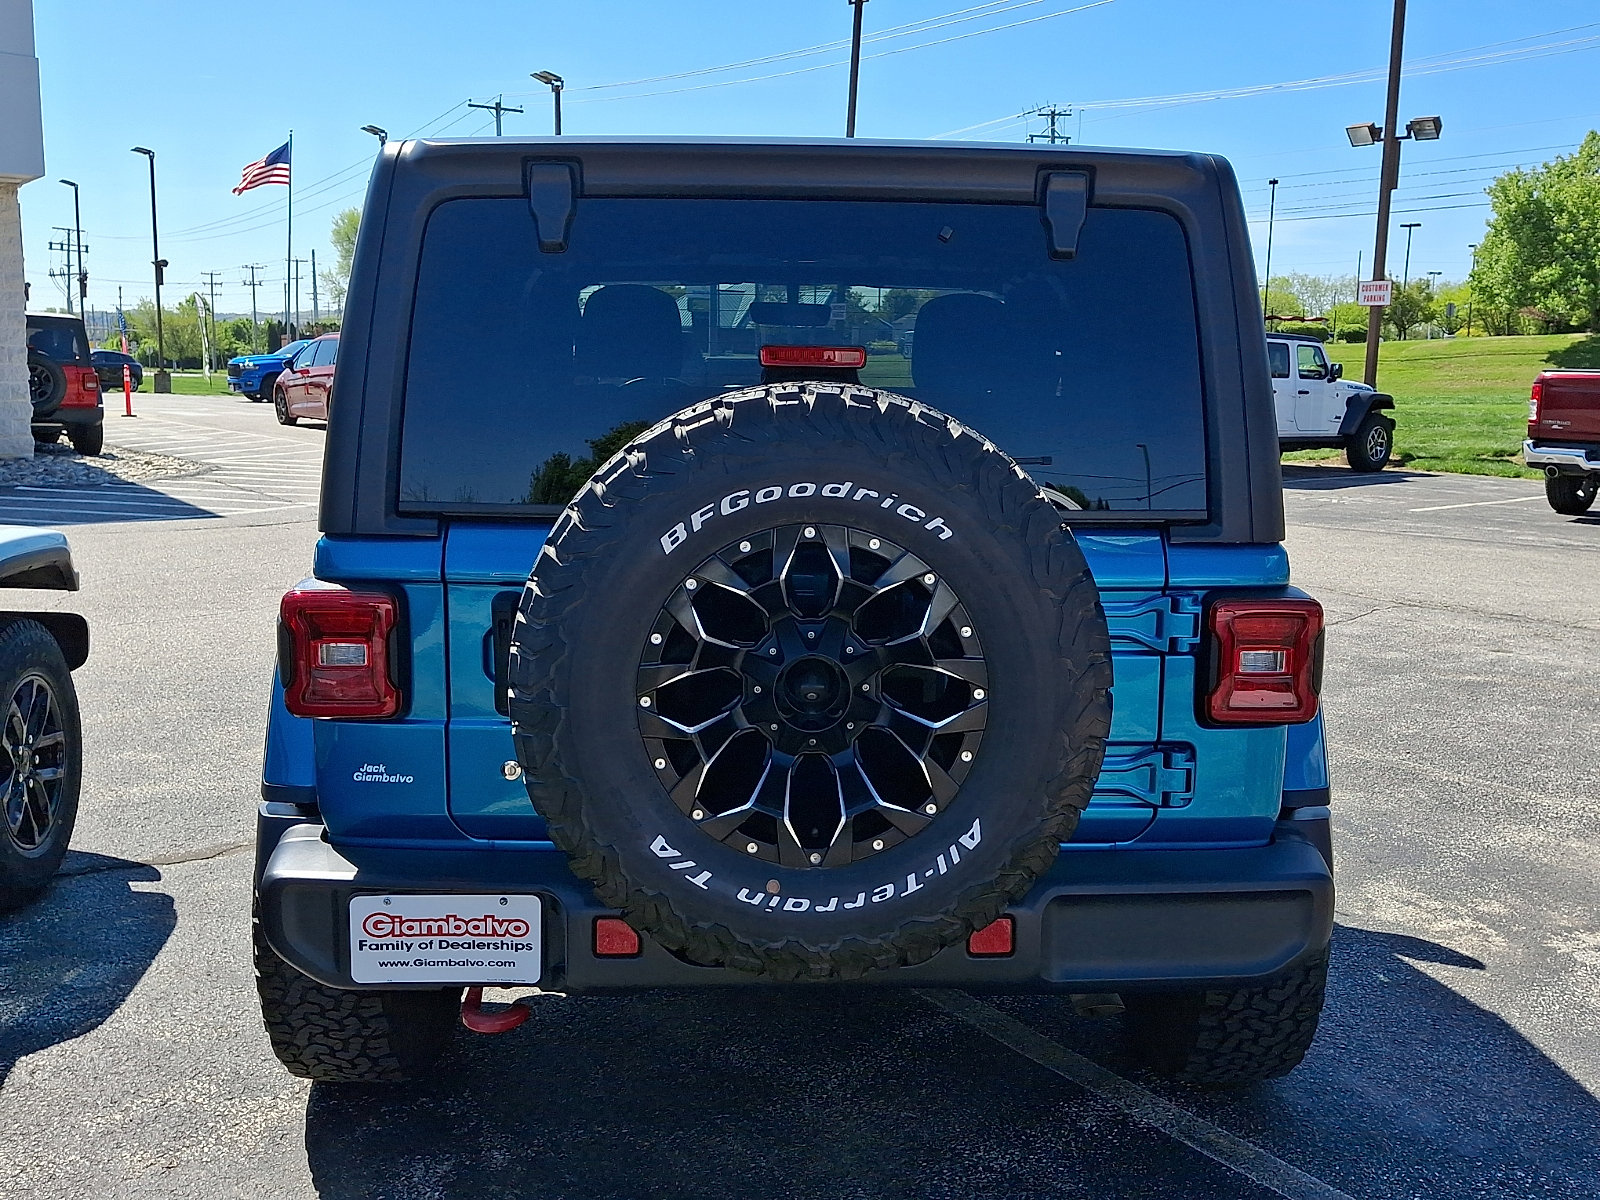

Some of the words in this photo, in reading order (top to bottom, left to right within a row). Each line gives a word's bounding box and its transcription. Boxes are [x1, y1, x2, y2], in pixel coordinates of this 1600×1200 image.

[1362, 284, 1388, 292] CUSTOMER
[1363, 294, 1385, 303] PARKING
[659, 480, 954, 556] BFGoodrich
[360, 763, 386, 773] Jack
[353, 772, 414, 784] Giambalvo
[649, 834, 713, 890] T/A
[736, 817, 982, 914] All-Terrain
[362, 912, 530, 938] Giambalvo
[358, 939, 414, 952] Family
[418, 939, 434, 951] of
[438, 939, 533, 952] Dealerships
[378, 958, 516, 968] www.Giambalvo.com
